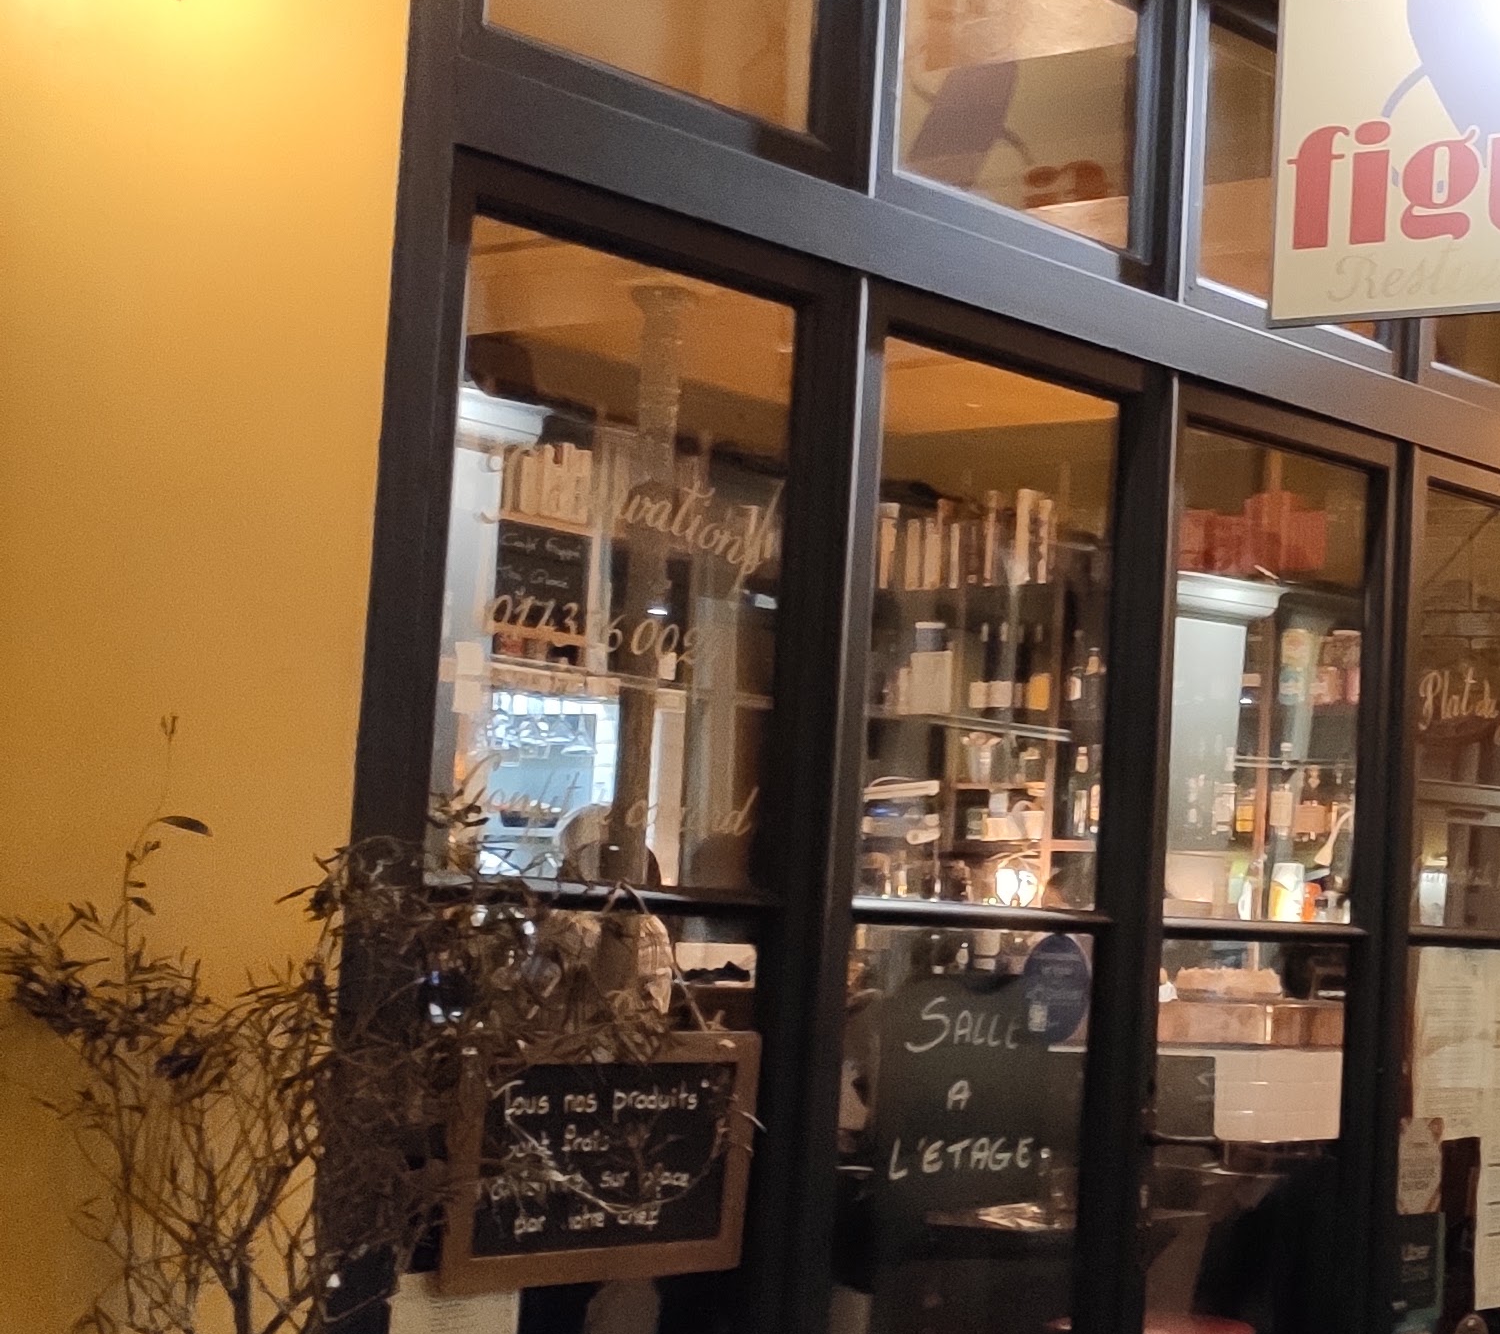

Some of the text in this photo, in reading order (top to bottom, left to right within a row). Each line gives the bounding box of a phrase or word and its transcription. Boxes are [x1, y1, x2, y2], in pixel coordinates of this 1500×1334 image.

[905, 996, 1022, 1053] SALLE
[564, 1092, 598, 1114] nos
[612, 1080, 698, 1123] produits
[946, 1080, 972, 1110] A
